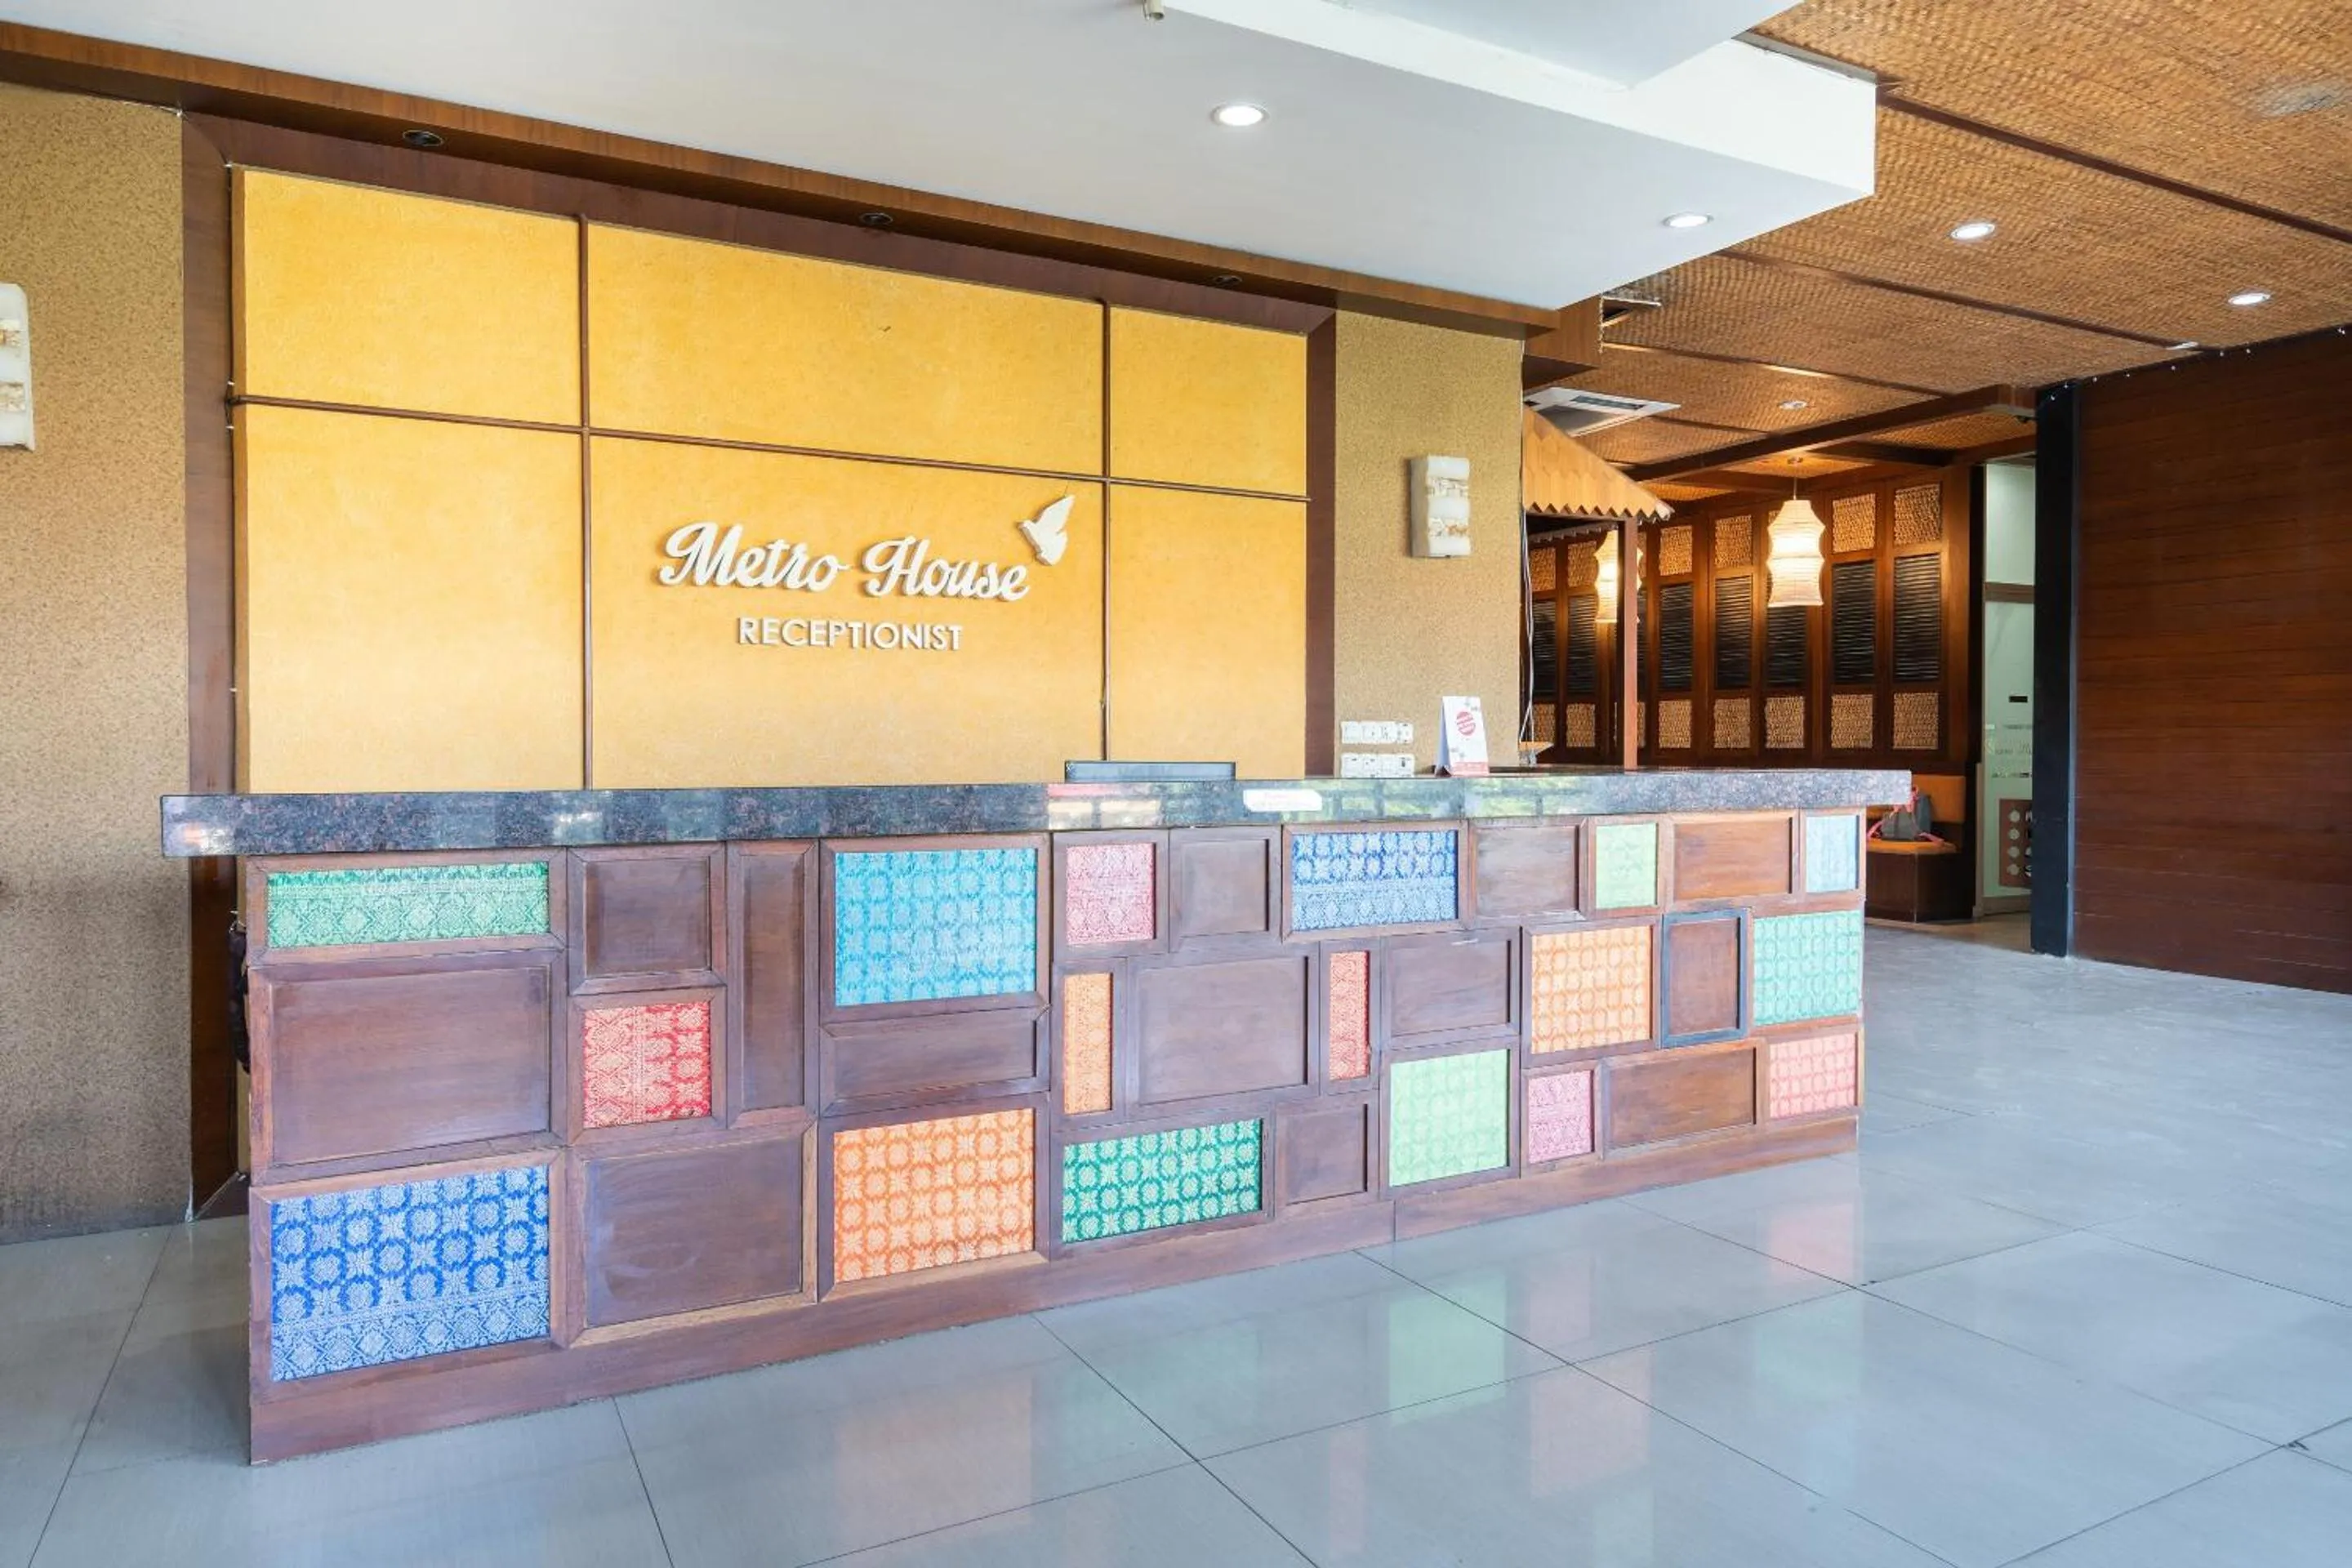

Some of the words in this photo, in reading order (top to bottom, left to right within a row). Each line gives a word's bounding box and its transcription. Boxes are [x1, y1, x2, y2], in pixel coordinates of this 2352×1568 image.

[657, 520, 849, 592] Metro
[861, 536, 1031, 602] House
[737, 617, 962, 650] RECEPTIONIST
